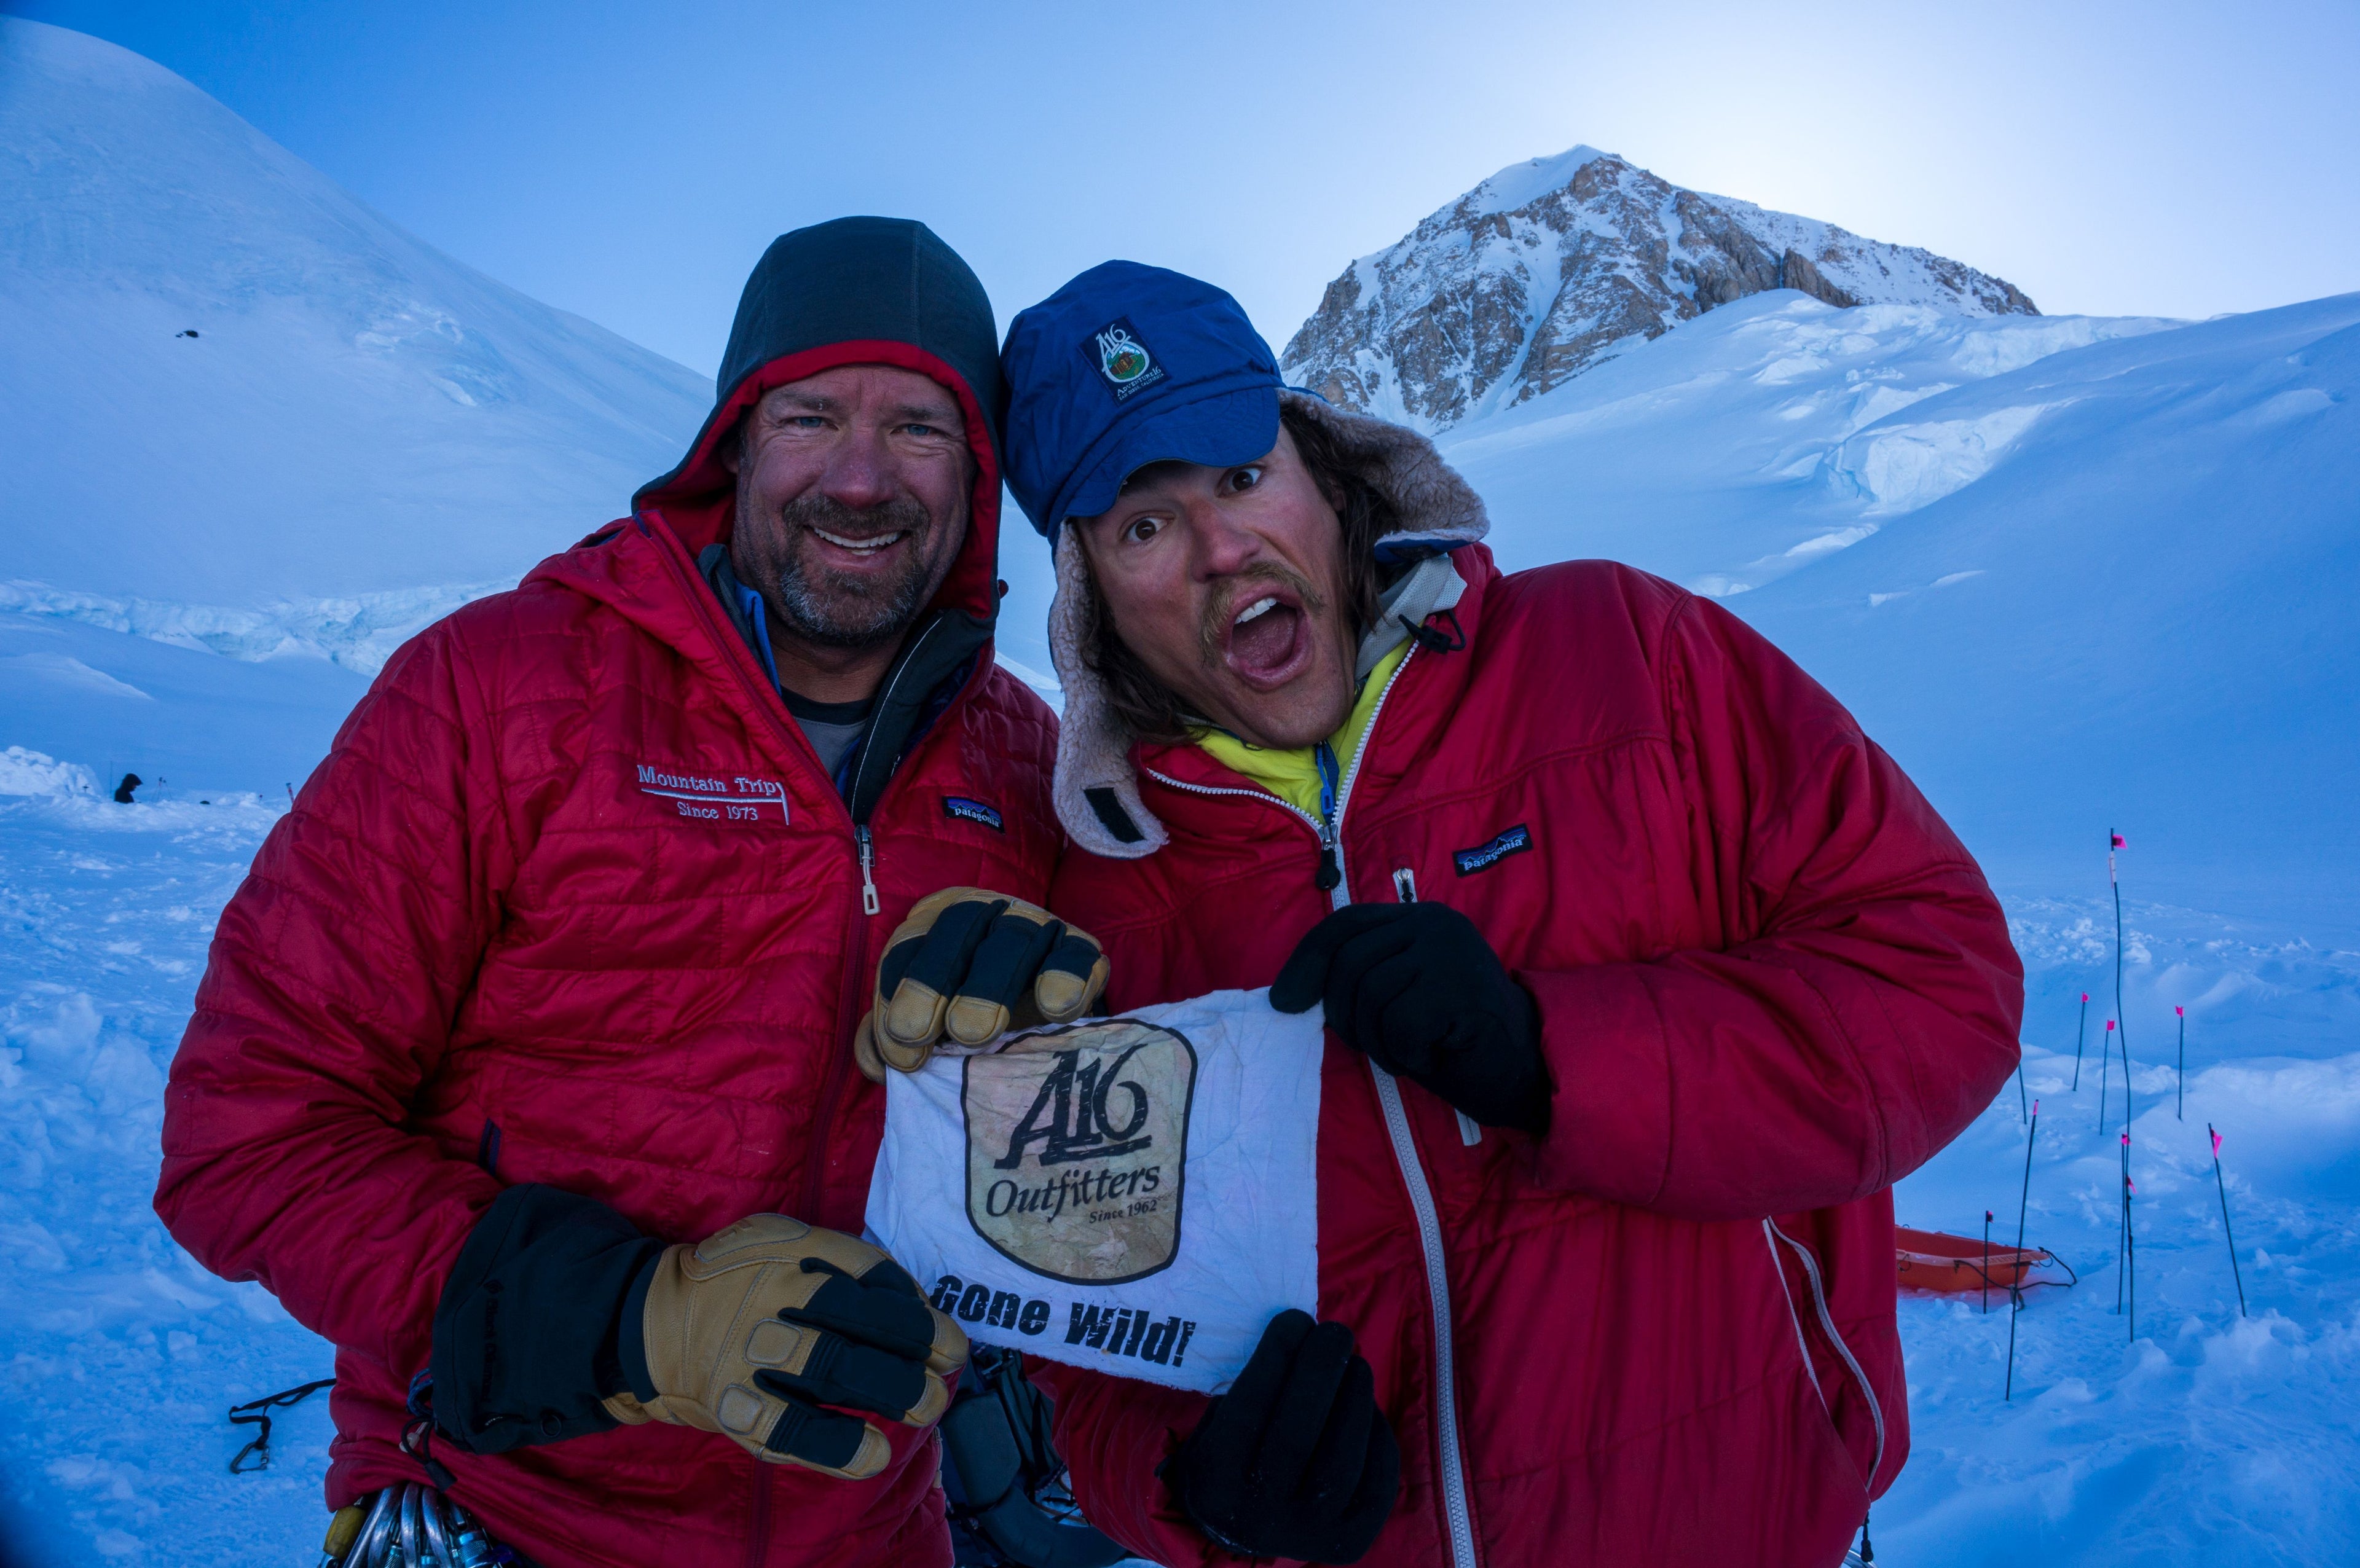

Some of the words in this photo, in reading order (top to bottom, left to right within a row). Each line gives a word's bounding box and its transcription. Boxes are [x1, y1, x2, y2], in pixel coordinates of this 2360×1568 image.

[1096, 324, 1131, 373] A16
[637, 764, 728, 793] Mountain
[734, 777, 777, 796] Trip
[677, 801, 719, 819] Since
[726, 806, 758, 820] 1973
[954, 807, 1000, 828] patagonia
[1463, 838, 1524, 871] patagonia
[994, 1044, 1152, 1169] A16
[986, 1166, 1161, 1223] Outfitters
[1089, 1209, 1124, 1224] Since
[1127, 1199, 1158, 1218] 1962
[929, 1274, 1051, 1336] Gone
[1064, 1301, 1197, 1368] Wild!
